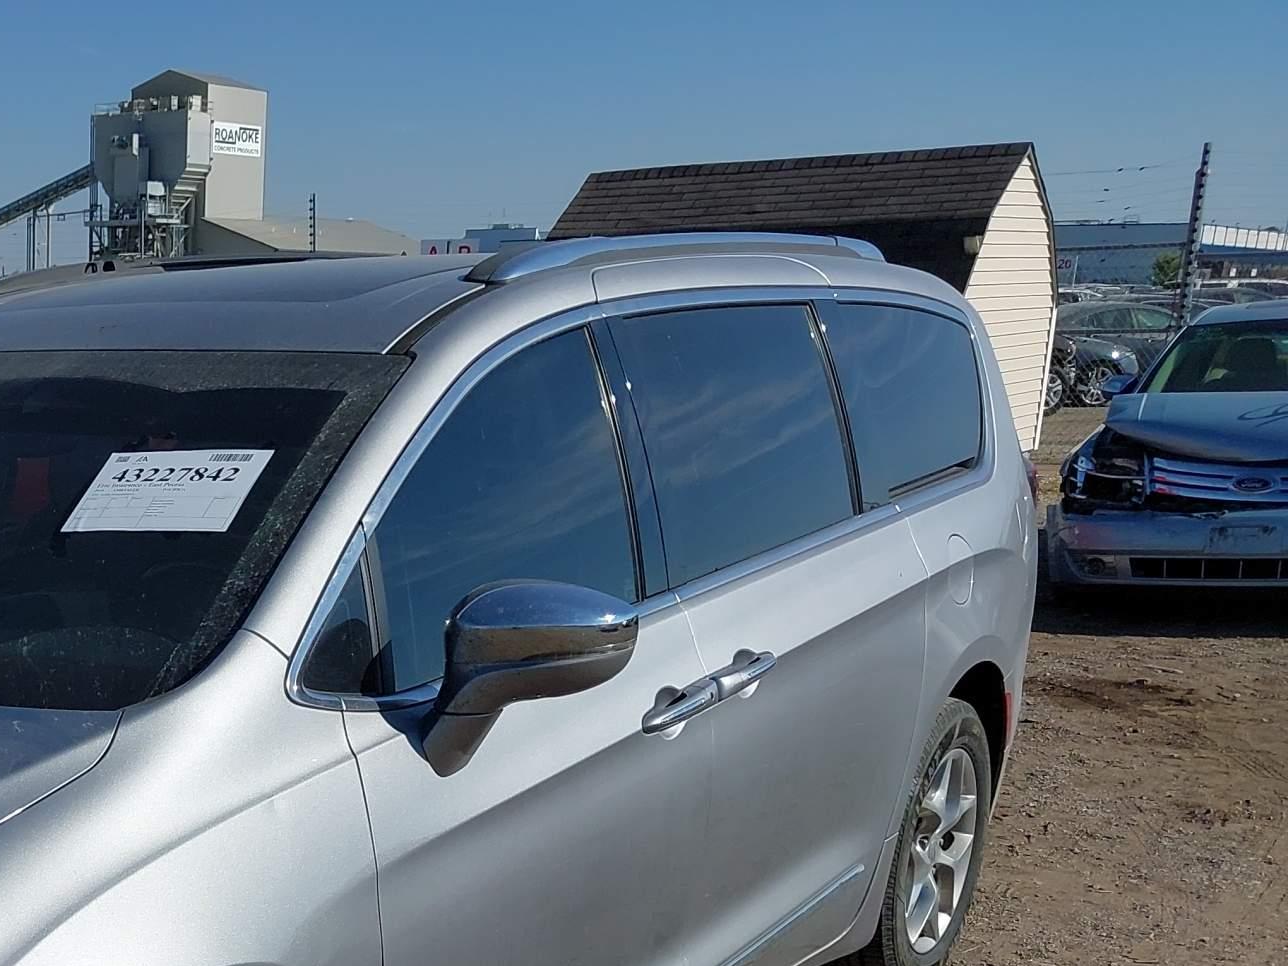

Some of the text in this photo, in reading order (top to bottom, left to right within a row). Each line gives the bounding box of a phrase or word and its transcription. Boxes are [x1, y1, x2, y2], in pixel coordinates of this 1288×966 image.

[214, 127, 260, 144] ROANOKE
[214, 145, 259, 155] CONCRETE PRODUCTS
[111, 467, 241, 483] 43227842
